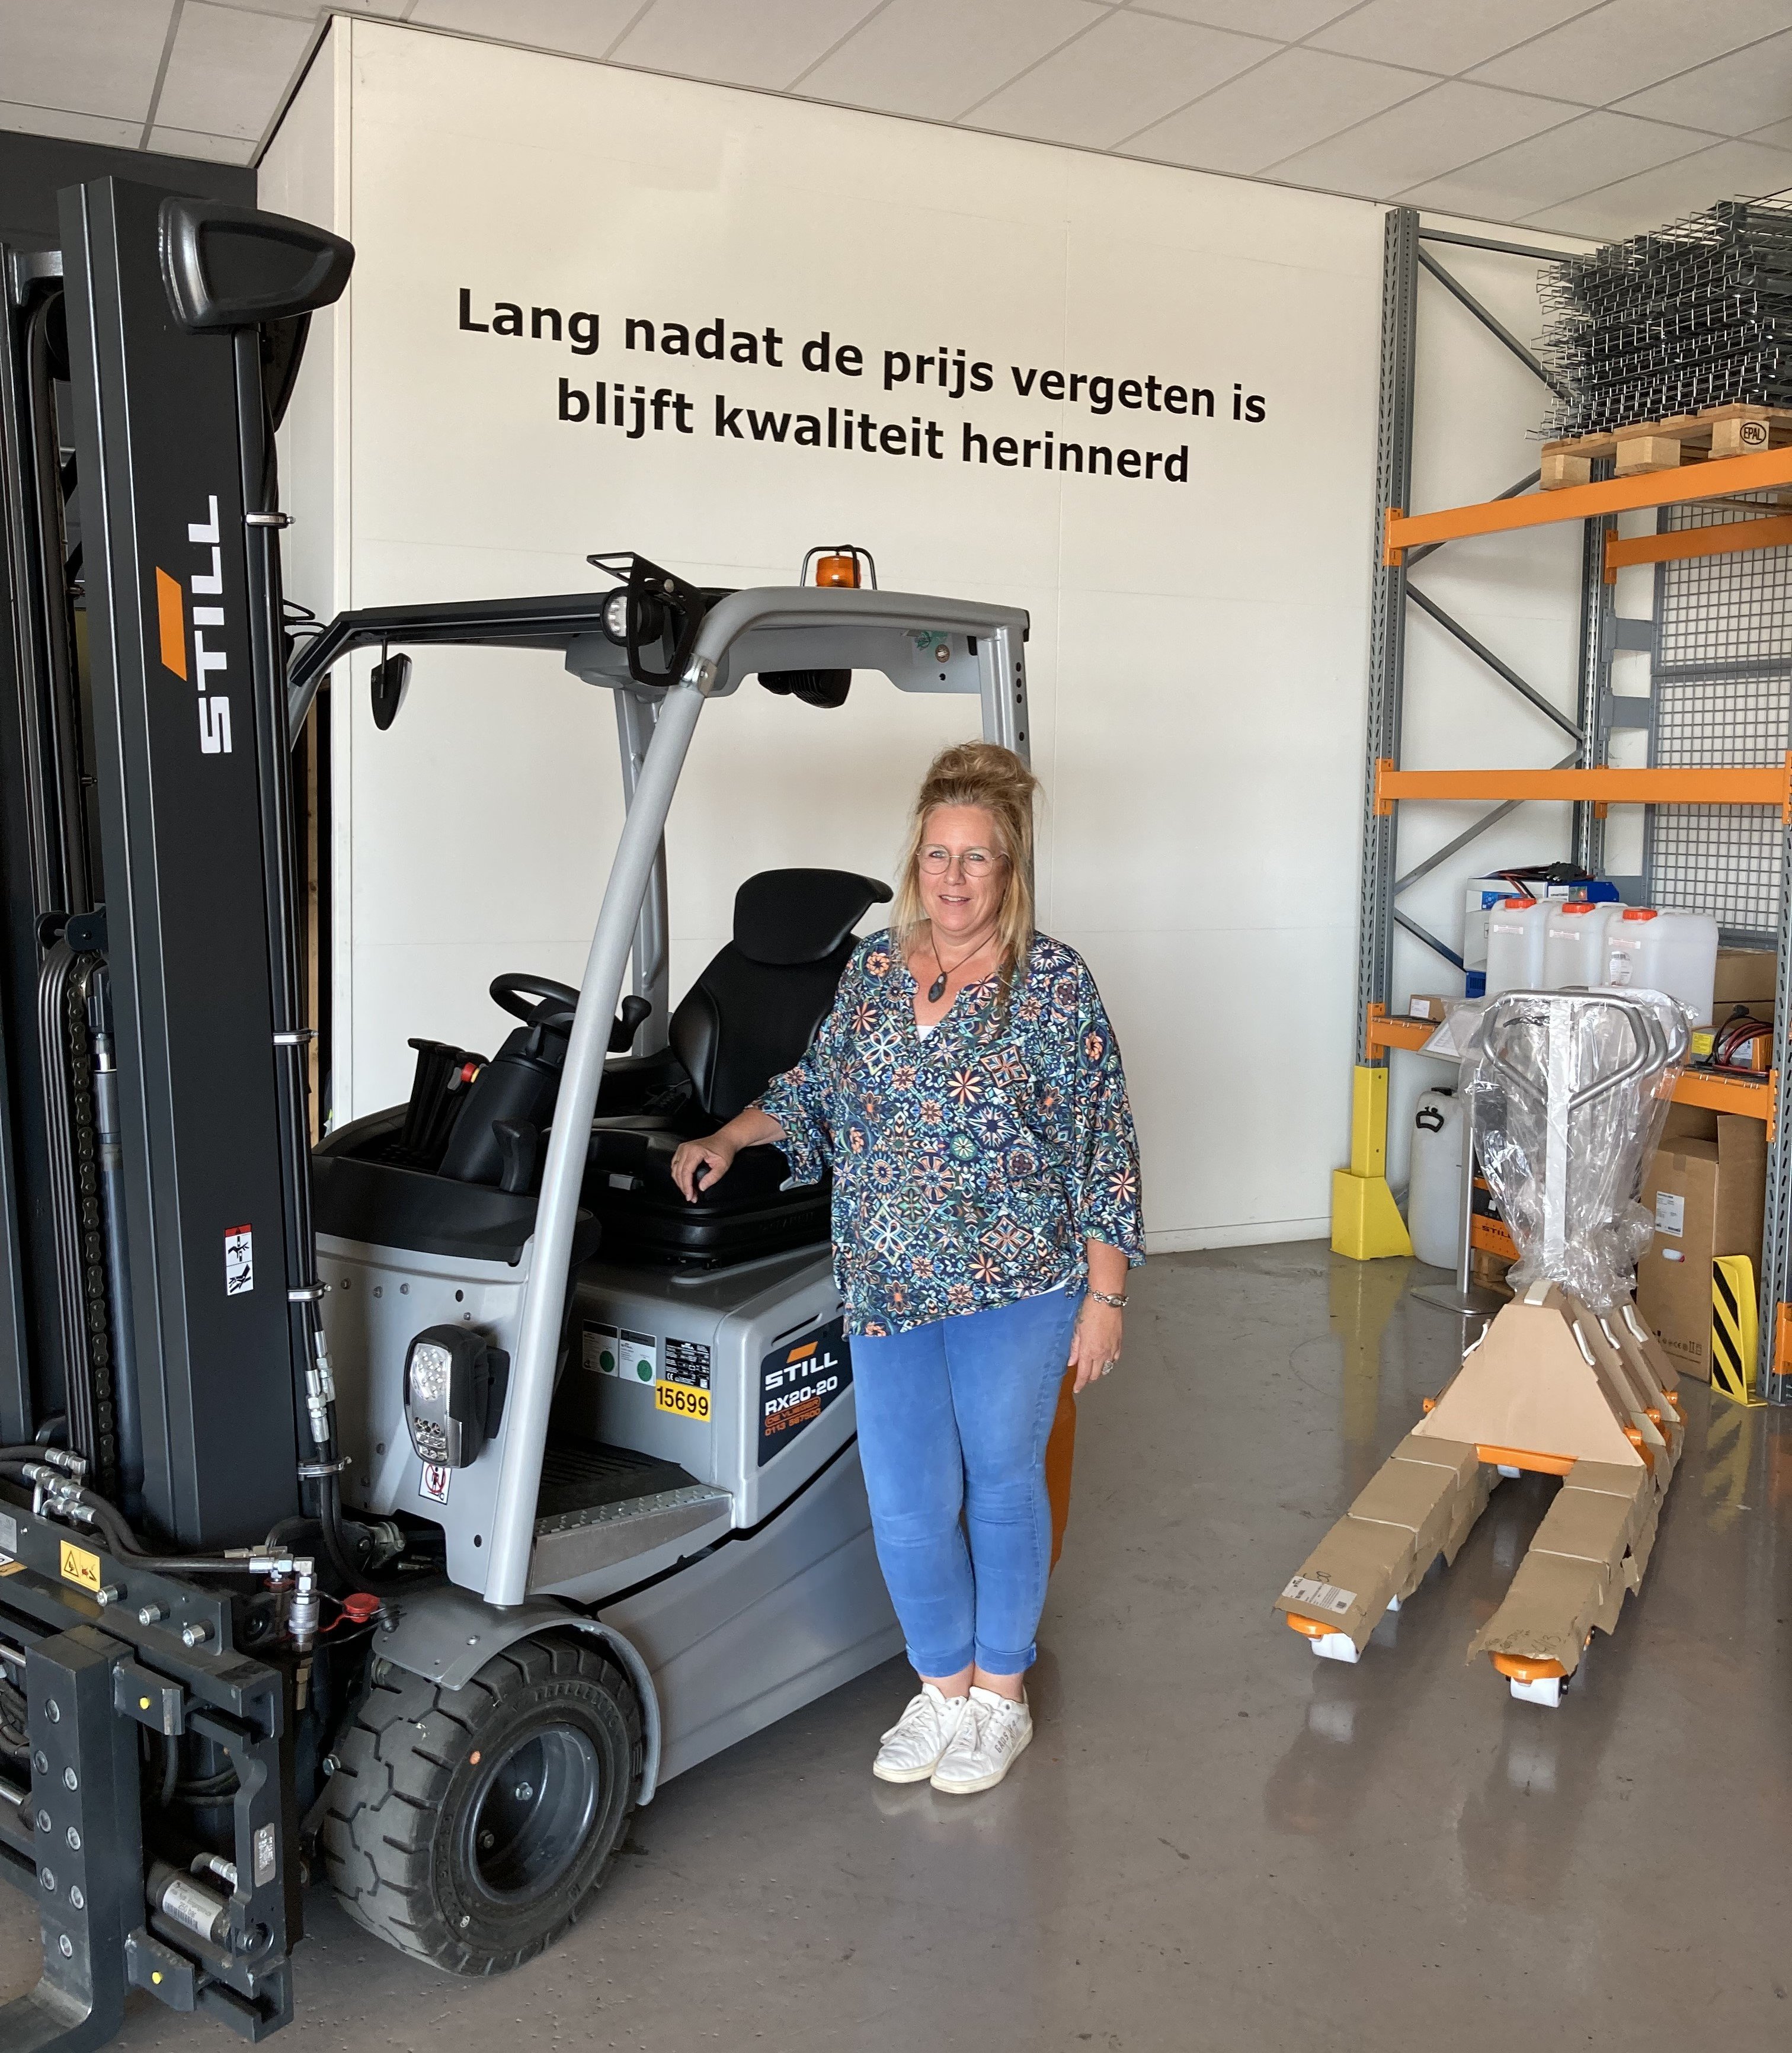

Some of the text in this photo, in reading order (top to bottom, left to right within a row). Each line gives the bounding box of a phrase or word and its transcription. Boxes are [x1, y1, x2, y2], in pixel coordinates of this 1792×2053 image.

[459, 287, 1266, 423] Lang nadat de prijs vergeten is
[558, 377, 1188, 483] blijft kwaliteit herinnerd
[1743, 427, 1762, 441] EPAL
[188, 495, 232, 754] STILL
[1482, 1225, 1512, 1239] STIL
[765, 1352, 839, 1391] STILL
[657, 1386, 708, 1416] 15699
[765, 1376, 838, 1416] RX20-20
